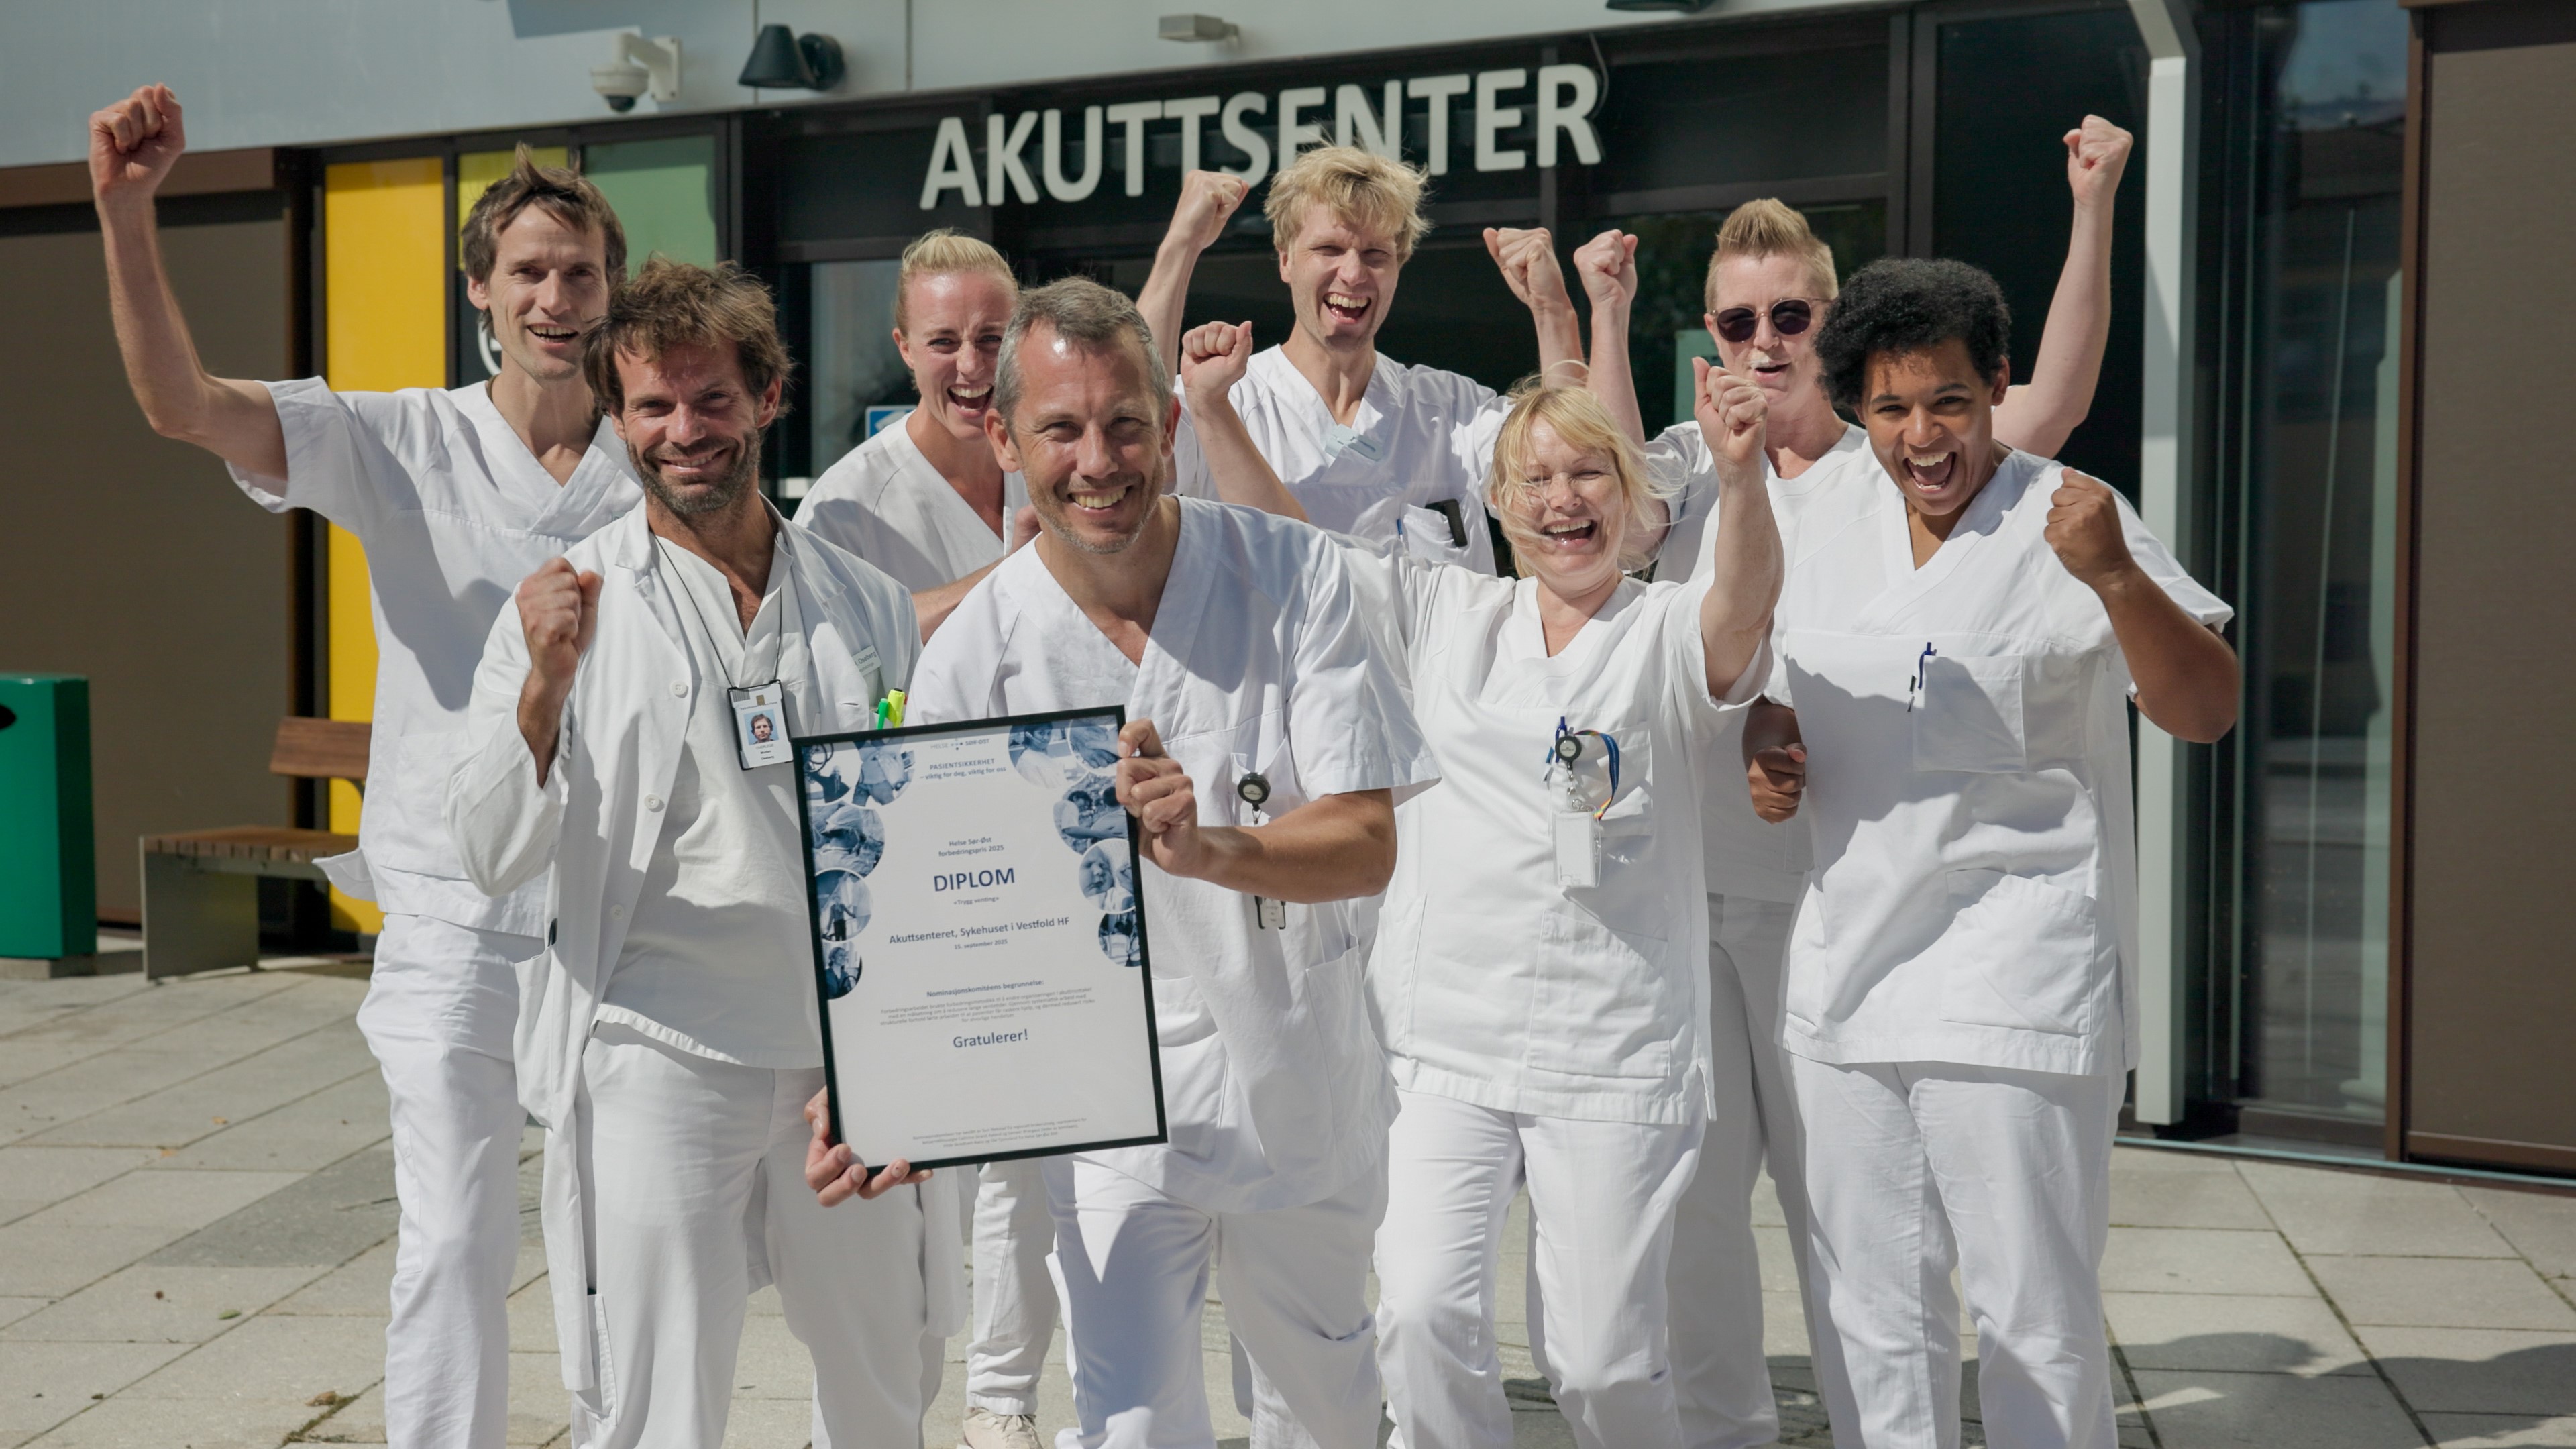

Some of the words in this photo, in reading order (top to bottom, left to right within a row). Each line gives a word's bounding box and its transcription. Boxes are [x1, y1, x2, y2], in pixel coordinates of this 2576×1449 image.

[920, 64, 1601, 210] AKUTTSENTER
[929, 757, 995, 771] PASIENTSIKKERHET
[967, 837, 992, 845] Sør-Øst
[938, 847, 987, 857] forbedringspris
[988, 844, 1004, 852] 2025
[933, 867, 1015, 892] DIPLOM
[889, 930, 958, 945] Akuttsenteret,
[960, 924, 1009, 938] Sykehuset
[1010, 922, 1014, 931] i
[1016, 918, 1055, 930] Vestfold
[1057, 916, 1069, 926] HF
[963, 941, 994, 949] september
[1002, 979, 1044, 990] begrunnelse:
[953, 1028, 1028, 1049] Gratulerer!
